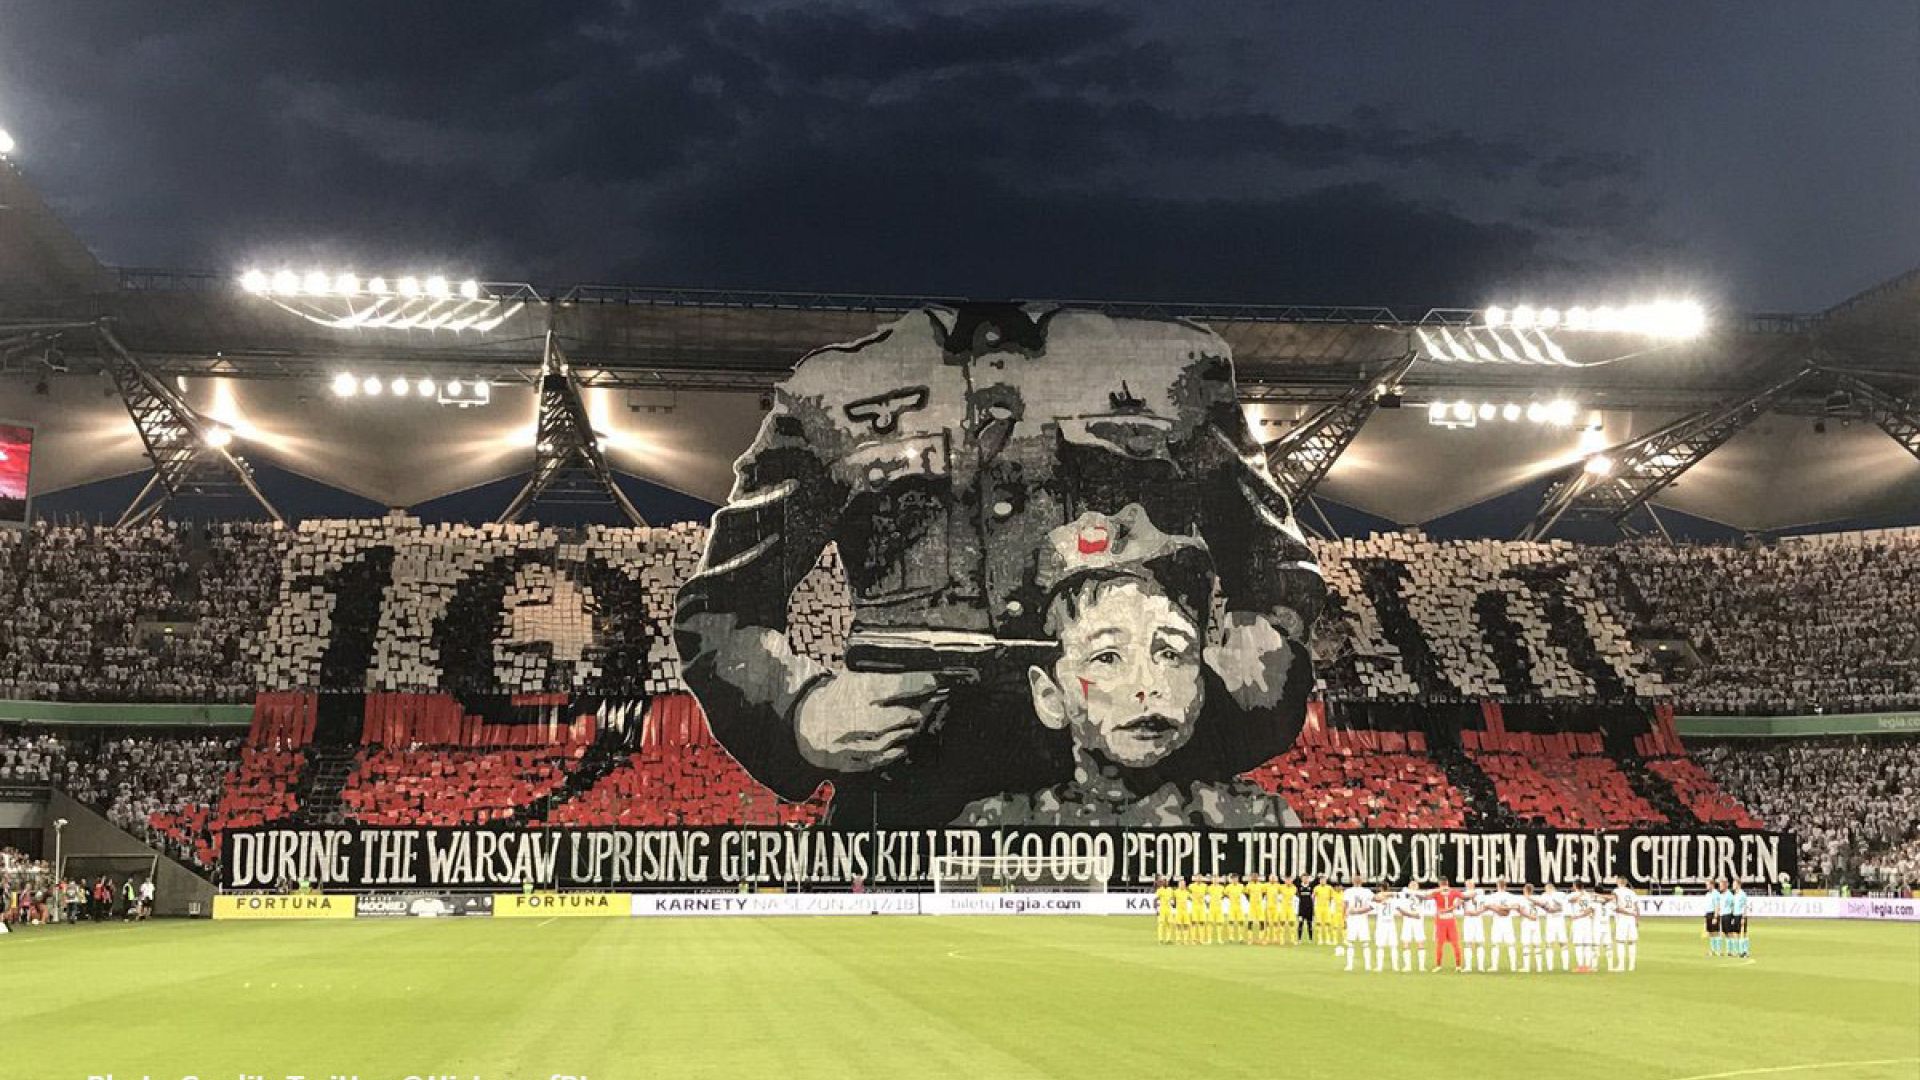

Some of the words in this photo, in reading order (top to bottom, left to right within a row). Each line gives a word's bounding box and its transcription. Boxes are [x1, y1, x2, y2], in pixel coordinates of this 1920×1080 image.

[231, 830, 353, 886] DURING
[360, 830, 420, 883] THE
[427, 830, 561, 883] WARSAW
[571, 830, 711, 883] UPRISING
[720, 830, 870, 883] GERMANS
[877, 830, 982, 883] KILLED
[1121, 832, 1229, 883] PEOPLE
[1238, 831, 1402, 884] THOUSANDS
[1410, 833, 1447, 884] OF
[1450, 833, 1527, 884] THEM
[1537, 833, 1620, 885] WERE
[1629, 834, 1791, 885] CHILDREN.
[236, 897, 332, 910] FORTUNA
[516, 895, 609, 908] FORTUNA
[655, 897, 748, 911] KARNETY
[999, 897, 1081, 912] legia.com
[1871, 901, 1914, 917] legia.com
